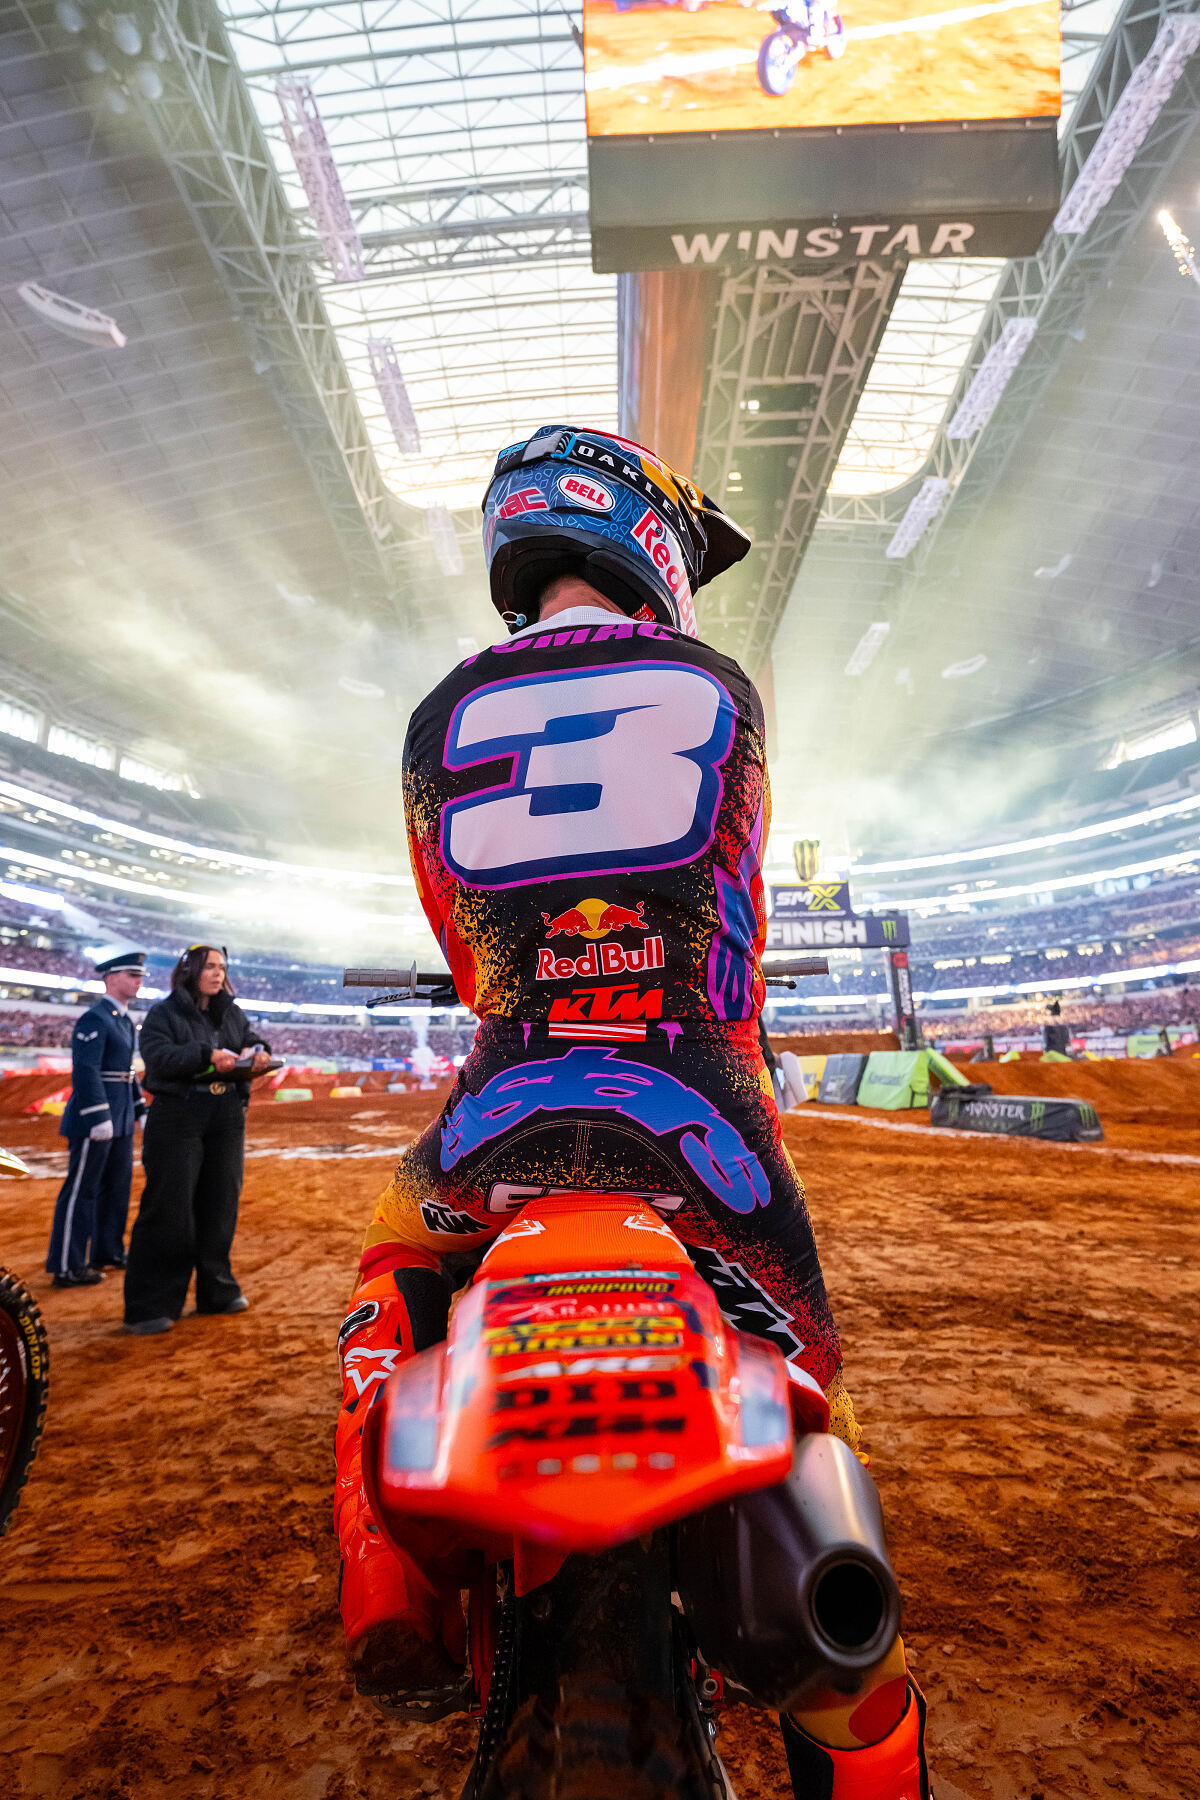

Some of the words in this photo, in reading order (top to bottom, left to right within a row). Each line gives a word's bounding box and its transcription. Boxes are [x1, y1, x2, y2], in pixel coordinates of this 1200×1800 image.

[671, 222, 975, 264] WINSTAR
[564, 478, 606, 508] BELL
[441, 663, 736, 887] 3
[775, 885, 842, 910] SMX
[767, 920, 868, 947] FINISH
[547, 983, 664, 1022] KTM
[419, 1198, 494, 1235] KTM
[20, 1314, 41, 1380] DUNLOP
